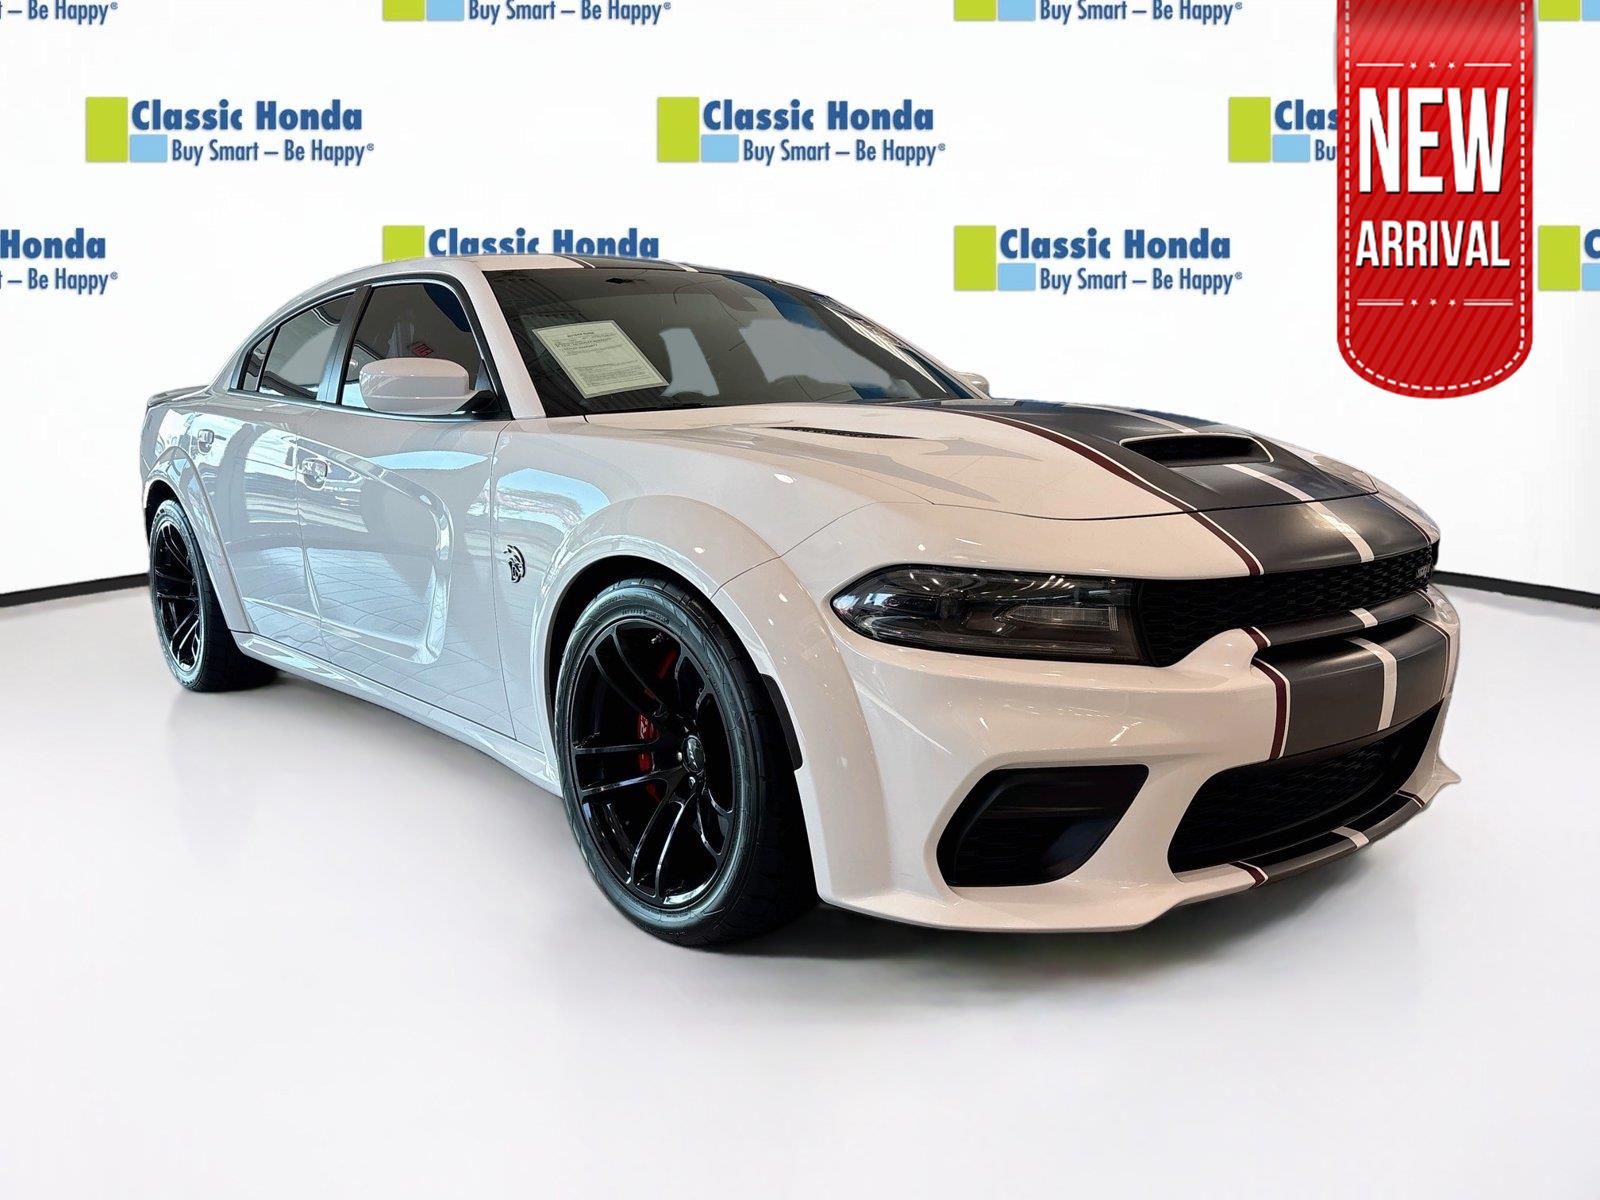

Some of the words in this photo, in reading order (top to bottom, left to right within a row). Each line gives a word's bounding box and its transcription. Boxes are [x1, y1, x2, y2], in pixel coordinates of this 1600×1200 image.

[27, 0, 49, 20] Be
[468, 0, 501, 25] Buy
[505, 0, 557, 20] Smart
[581, 0, 603, 20] Be
[1040, 0, 1073, 25] Buy
[1076, 0, 1128, 20] Smart
[1152, 0, 1174, 20] Be
[131, 98, 243, 131] Classic
[255, 98, 363, 131] Honda
[702, 98, 814, 131] Classic
[827, 98, 934, 131] Honda
[1274, 98, 1337, 131] Clas
[171, 138, 204, 166] Buy
[208, 138, 260, 162] Smart
[284, 138, 306, 162] Be
[743, 138, 775, 166] Buy
[780, 138, 831, 162] Smart
[855, 138, 877, 162] Be
[1314, 138, 1337, 162] Bu
[0, 227, 106, 260] Honda
[428, 227, 540, 256] Classic
[552, 227, 660, 259] Honda
[999, 227, 1111, 260] Classic
[1124, 227, 1231, 260] Honda
[27, 267, 49, 290] Be
[1040, 267, 1072, 294] Buy
[1076, 267, 1128, 290] Smart
[1152, 267, 1174, 290] Be
